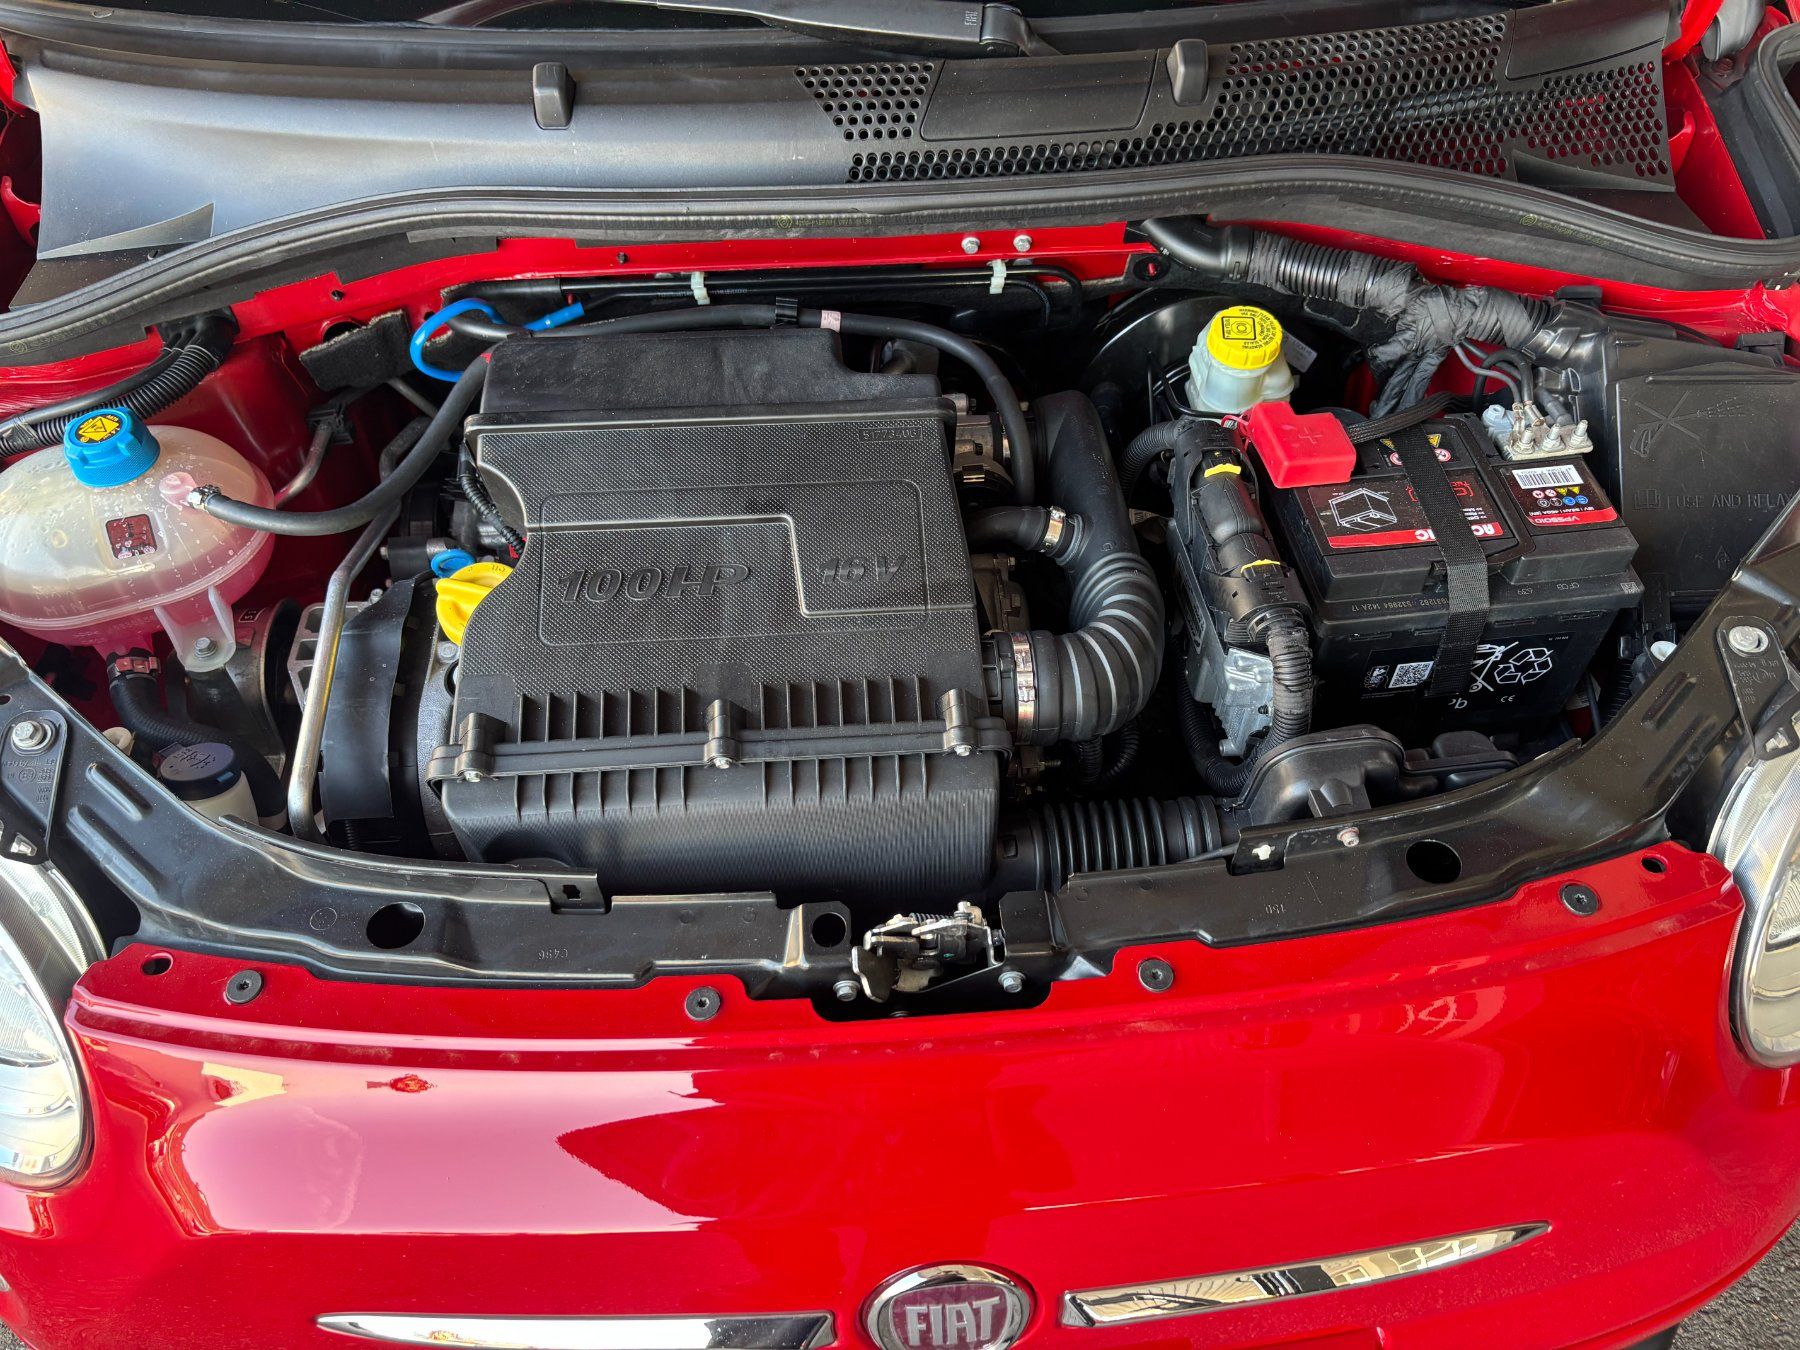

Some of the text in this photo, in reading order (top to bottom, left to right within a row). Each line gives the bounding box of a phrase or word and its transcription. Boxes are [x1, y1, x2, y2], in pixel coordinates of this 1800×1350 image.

[1711, 493, 1741, 508] AND
[556, 555, 905, 602] 100HP 16V
[904, 1296, 1001, 1346] FIAT
